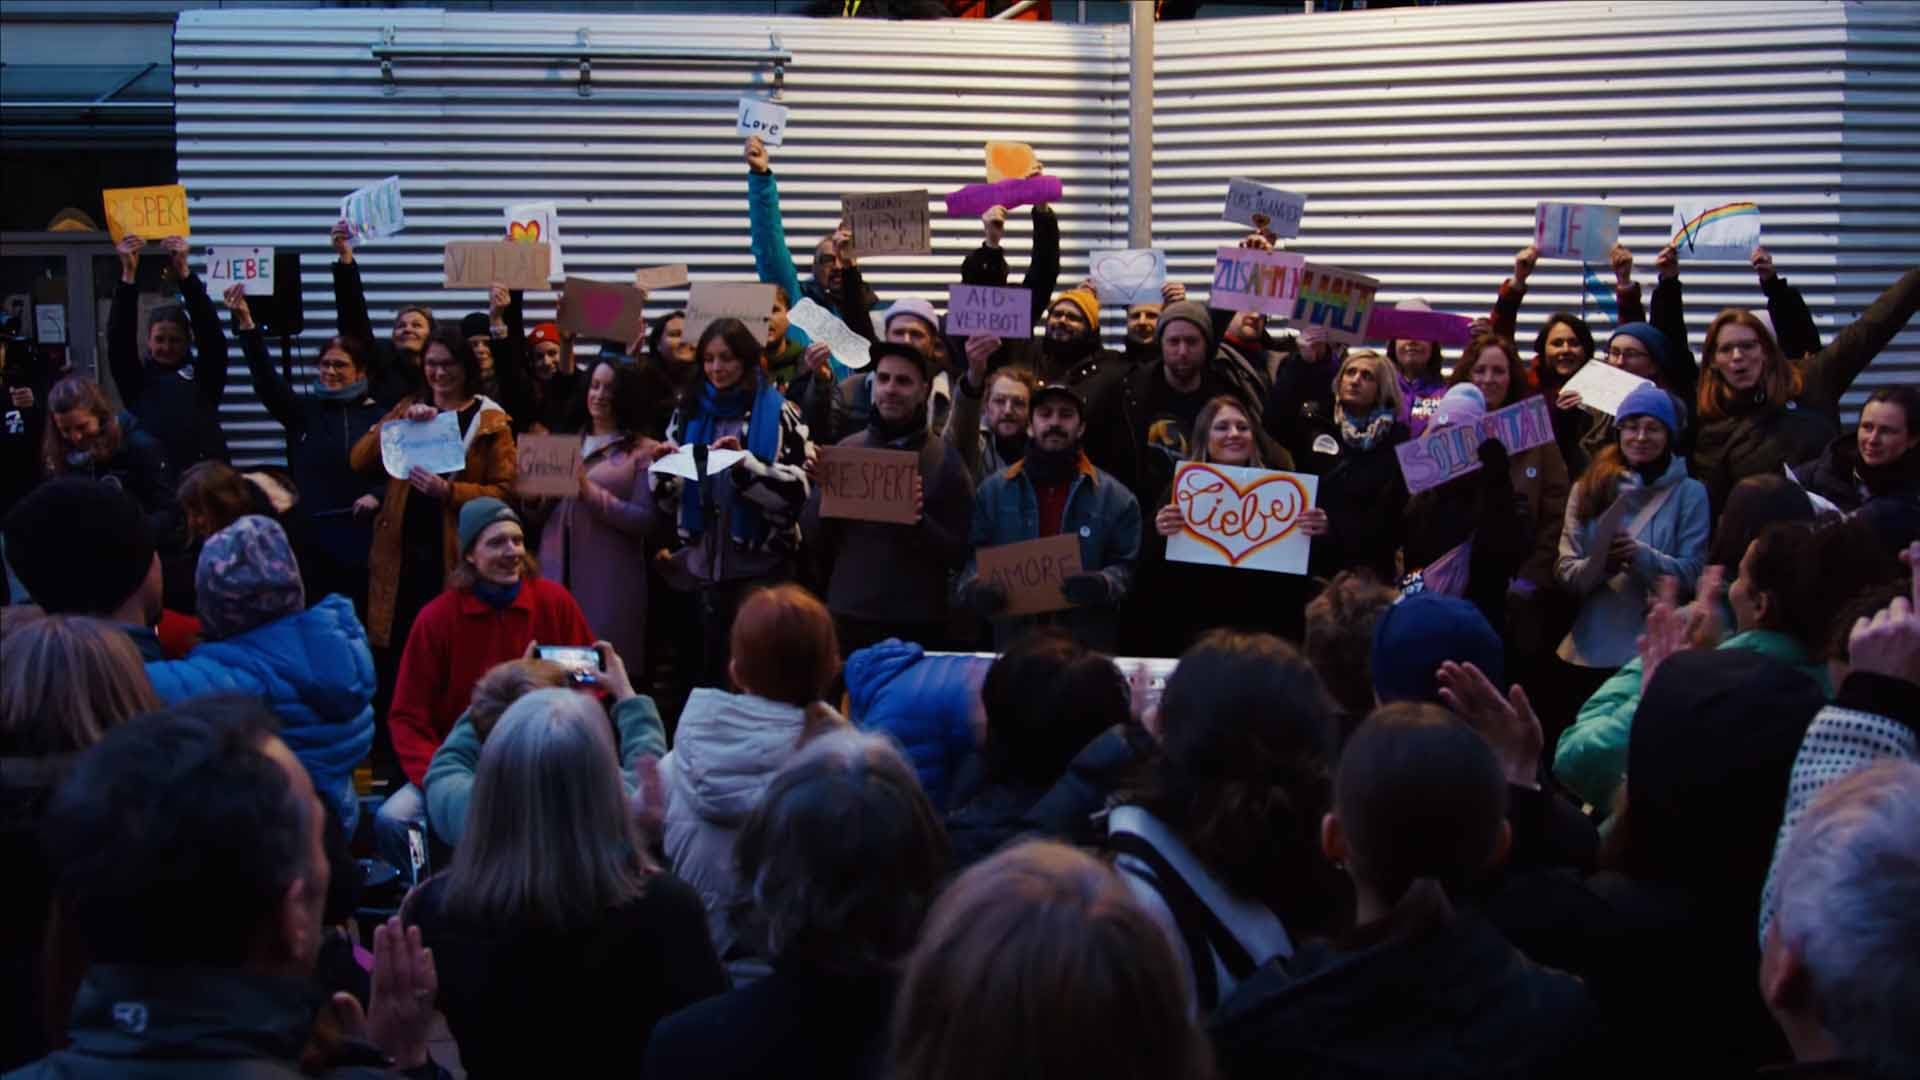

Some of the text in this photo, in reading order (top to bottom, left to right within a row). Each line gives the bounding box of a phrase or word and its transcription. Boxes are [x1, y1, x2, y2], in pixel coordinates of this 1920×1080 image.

[742, 109, 780, 136] Love
[212, 257, 270, 281] LIEBE
[953, 311, 1023, 332] VERBOT
[823, 460, 914, 501] RESPEKT
[1179, 472, 1295, 541] Liebe
[992, 552, 1074, 592] AMORE
